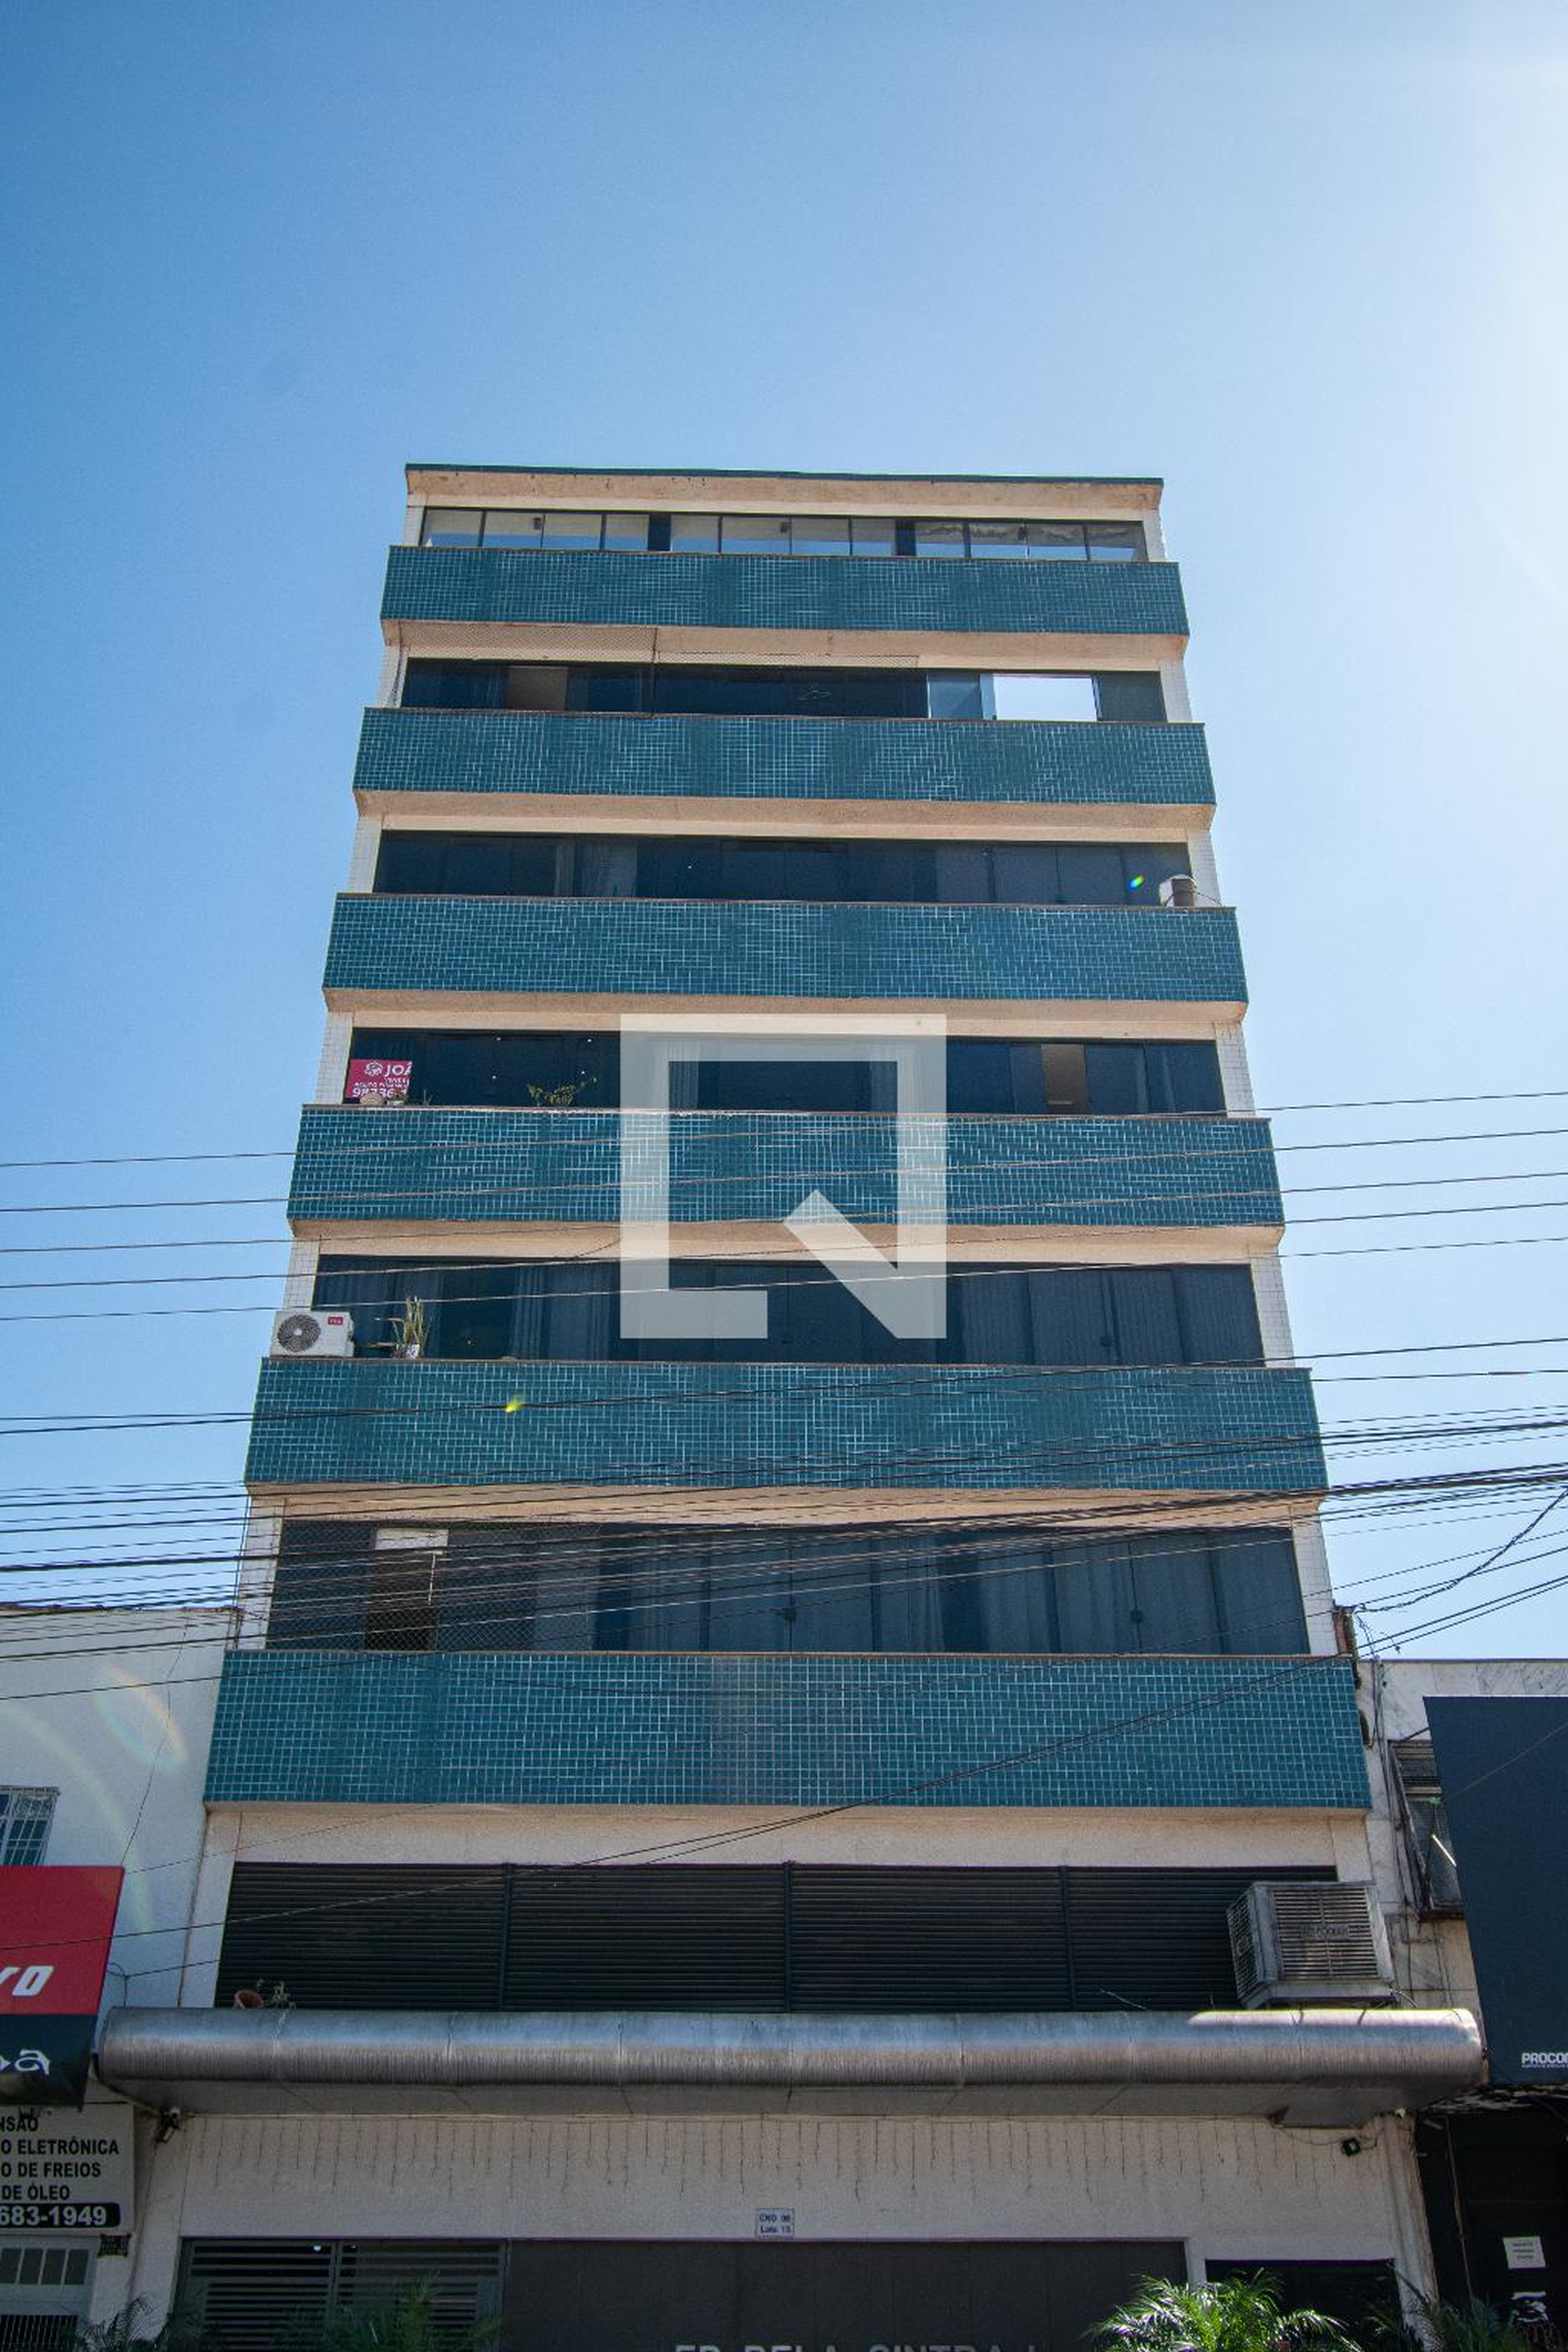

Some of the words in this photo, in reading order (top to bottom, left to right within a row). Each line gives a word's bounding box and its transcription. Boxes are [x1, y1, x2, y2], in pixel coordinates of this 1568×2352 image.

[18, 2136, 119, 2154] ELETRÔNICA
[18, 2163, 38, 2177] DE
[44, 2163, 101, 2177] FREIOS
[2, 2185, 22, 2200] DE
[27, 2182, 70, 2200] ÓLEO
[0, 2206, 107, 2225] 683-1949
